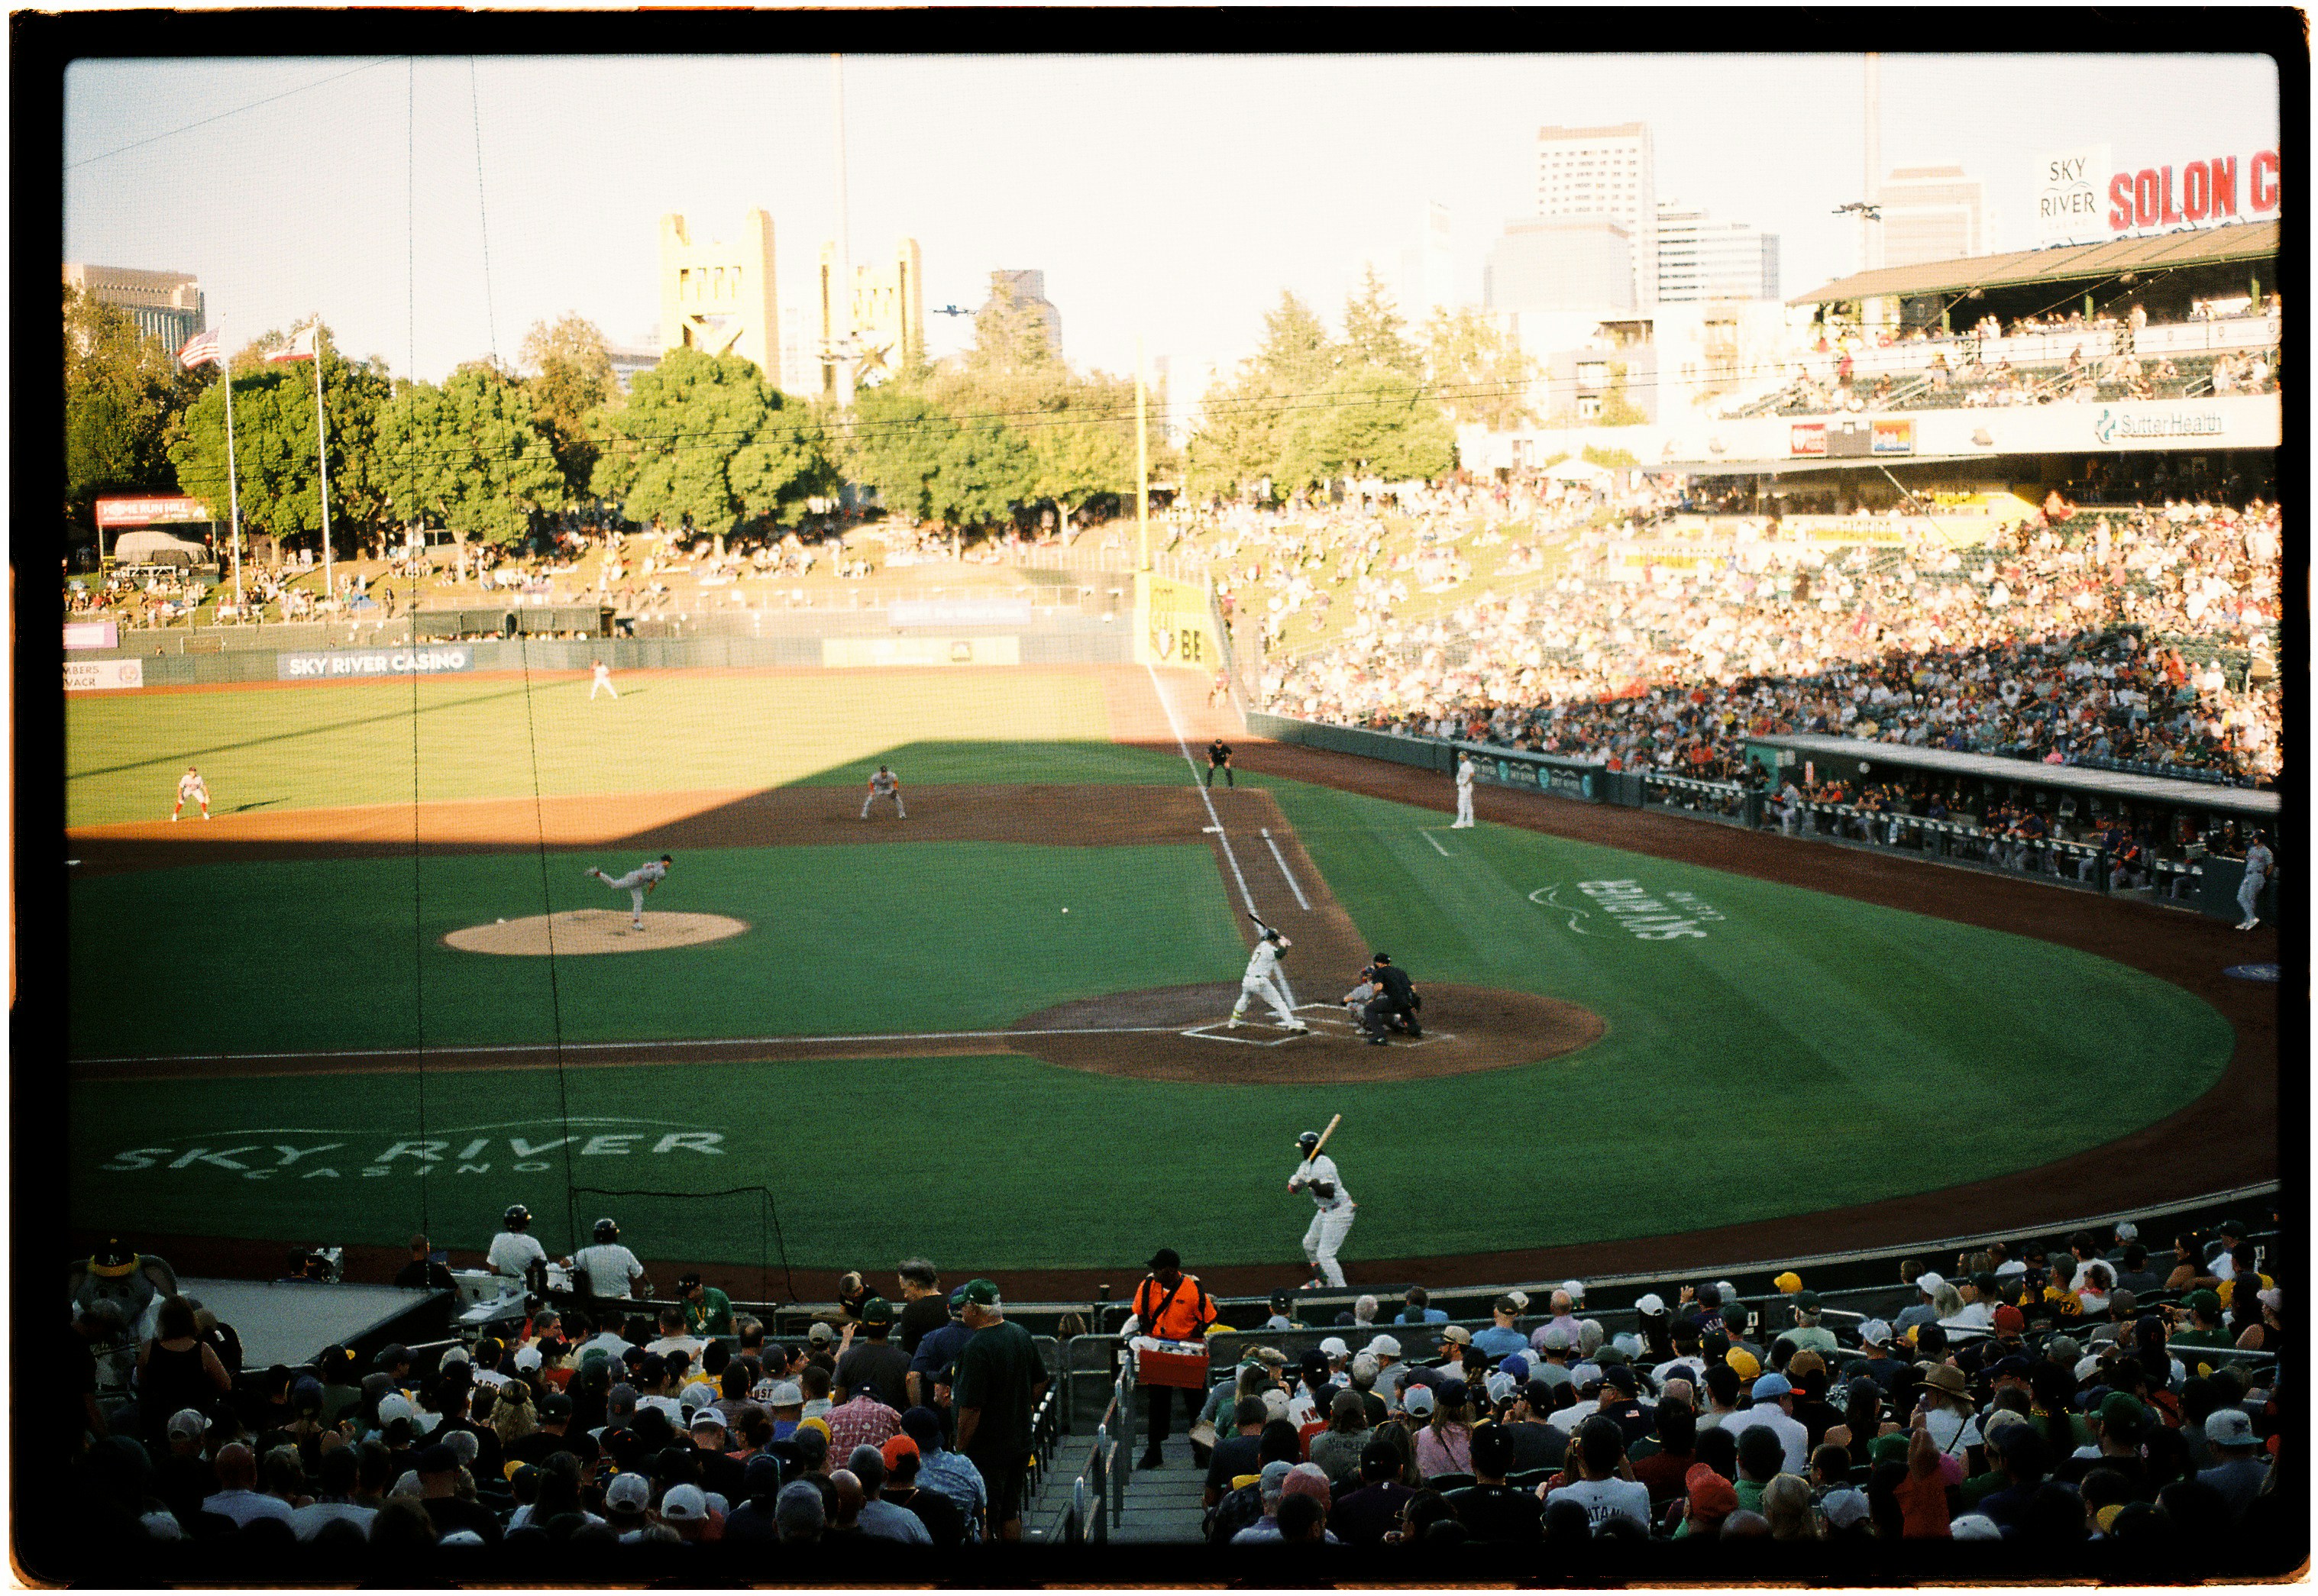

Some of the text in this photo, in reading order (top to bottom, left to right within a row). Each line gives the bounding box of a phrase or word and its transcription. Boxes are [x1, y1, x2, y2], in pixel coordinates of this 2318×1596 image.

[2050, 157, 2087, 182] SKY
[2108, 153, 2238, 231] SOLON
[2040, 192, 2096, 218] RIVER
[2122, 412, 2223, 435] Sutter Health
[140, 502, 163, 514] RUN
[164, 502, 188, 513] HILL
[289, 652, 465, 674] SKY RIVER CASINO
[99, 1132, 726, 1171] SKY RIVER
[242, 1161, 551, 1179] CASINO
